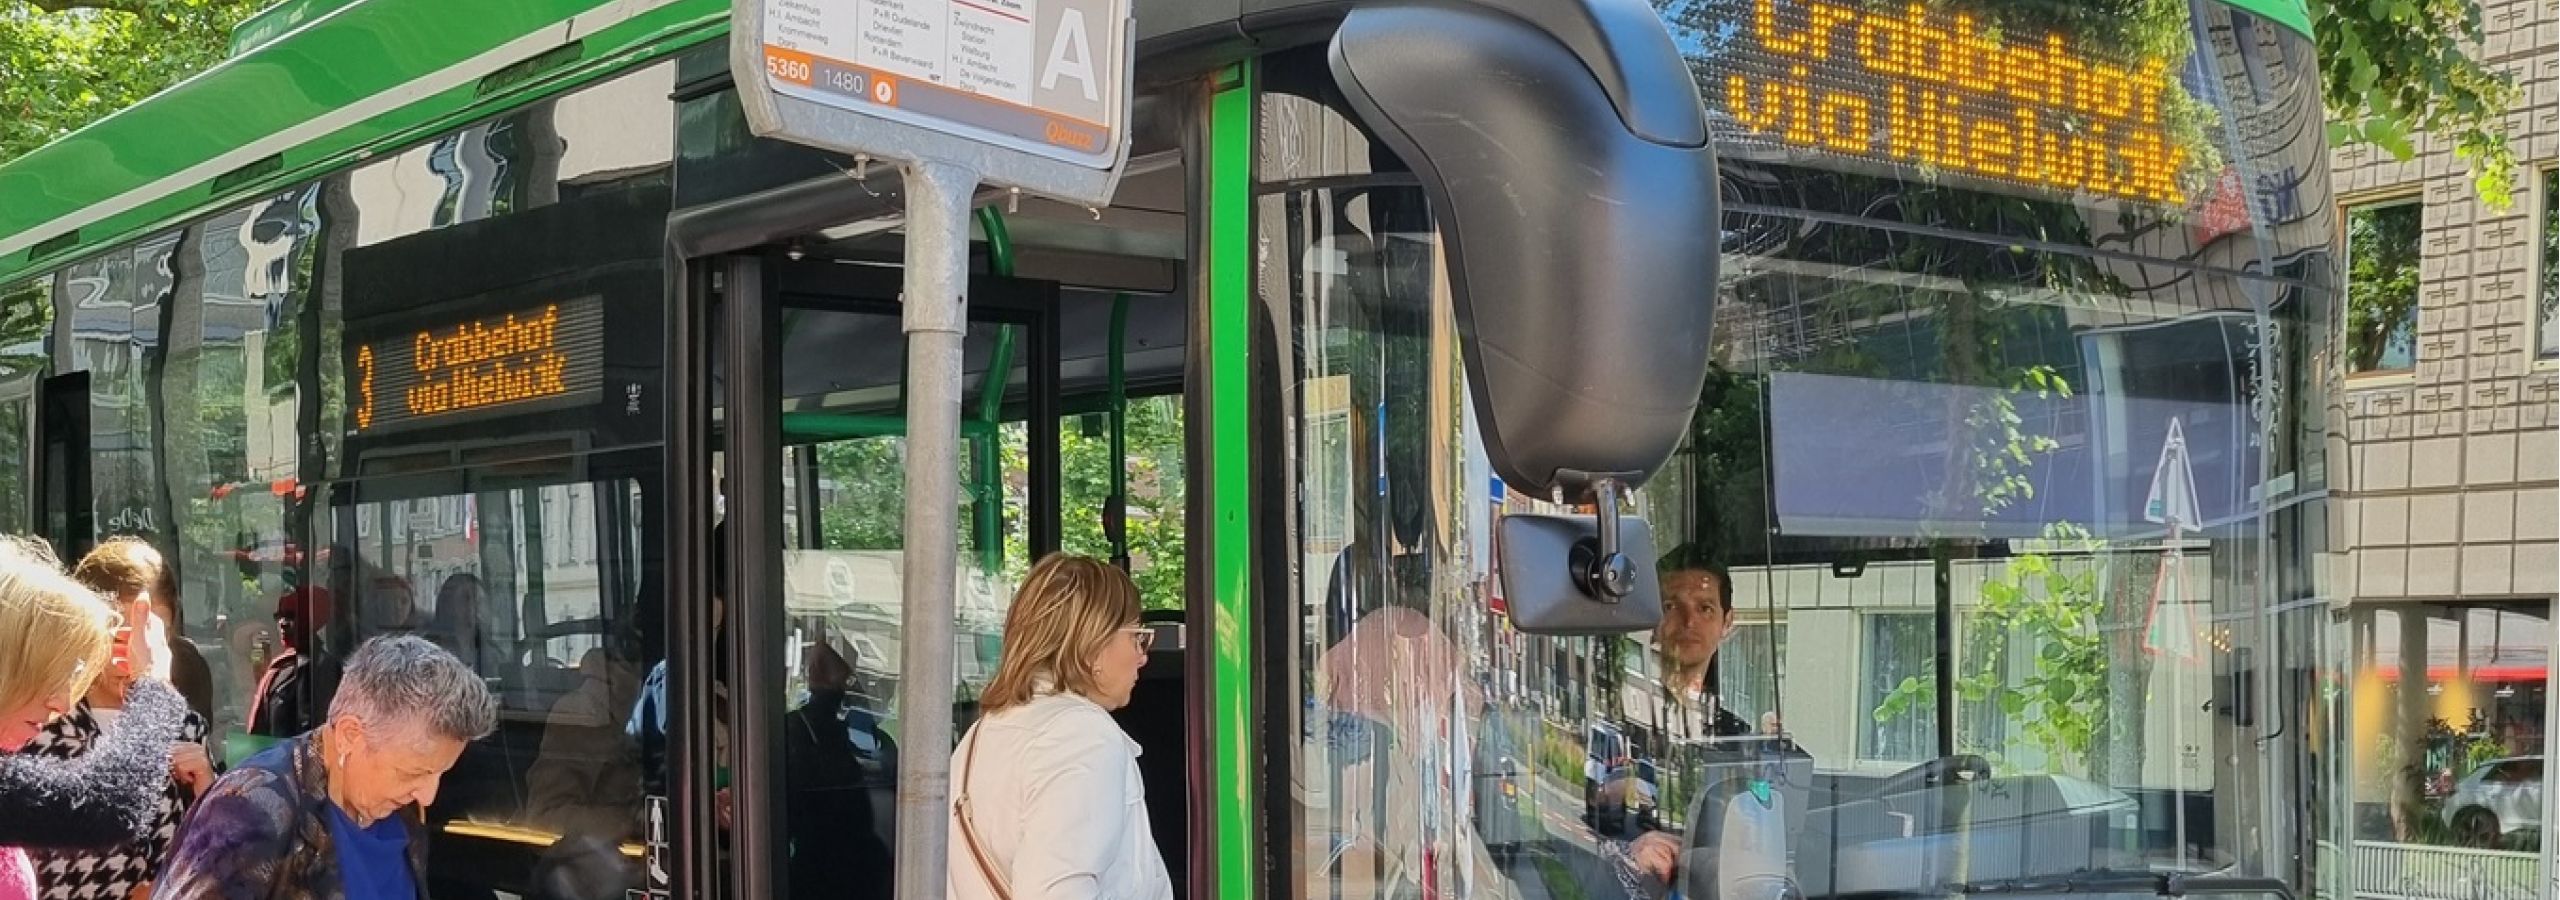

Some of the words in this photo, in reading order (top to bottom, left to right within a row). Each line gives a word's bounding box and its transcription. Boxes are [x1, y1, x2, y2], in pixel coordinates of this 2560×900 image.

[767, 56, 810, 81] 5360
[823, 68, 865, 94] 1480
[1040, 8, 1099, 101] A
[1757, 0, 2166, 125] Crabbehof
[1045, 120, 1094, 150] Qbuzz
[1726, 65, 1870, 153] via
[1890, 83, 2187, 205] Wielwijk
[415, 303, 558, 372] Crabbehof
[357, 345, 373, 430] 3
[408, 374, 448, 415] via
[453, 353, 568, 409] Wielwijk
